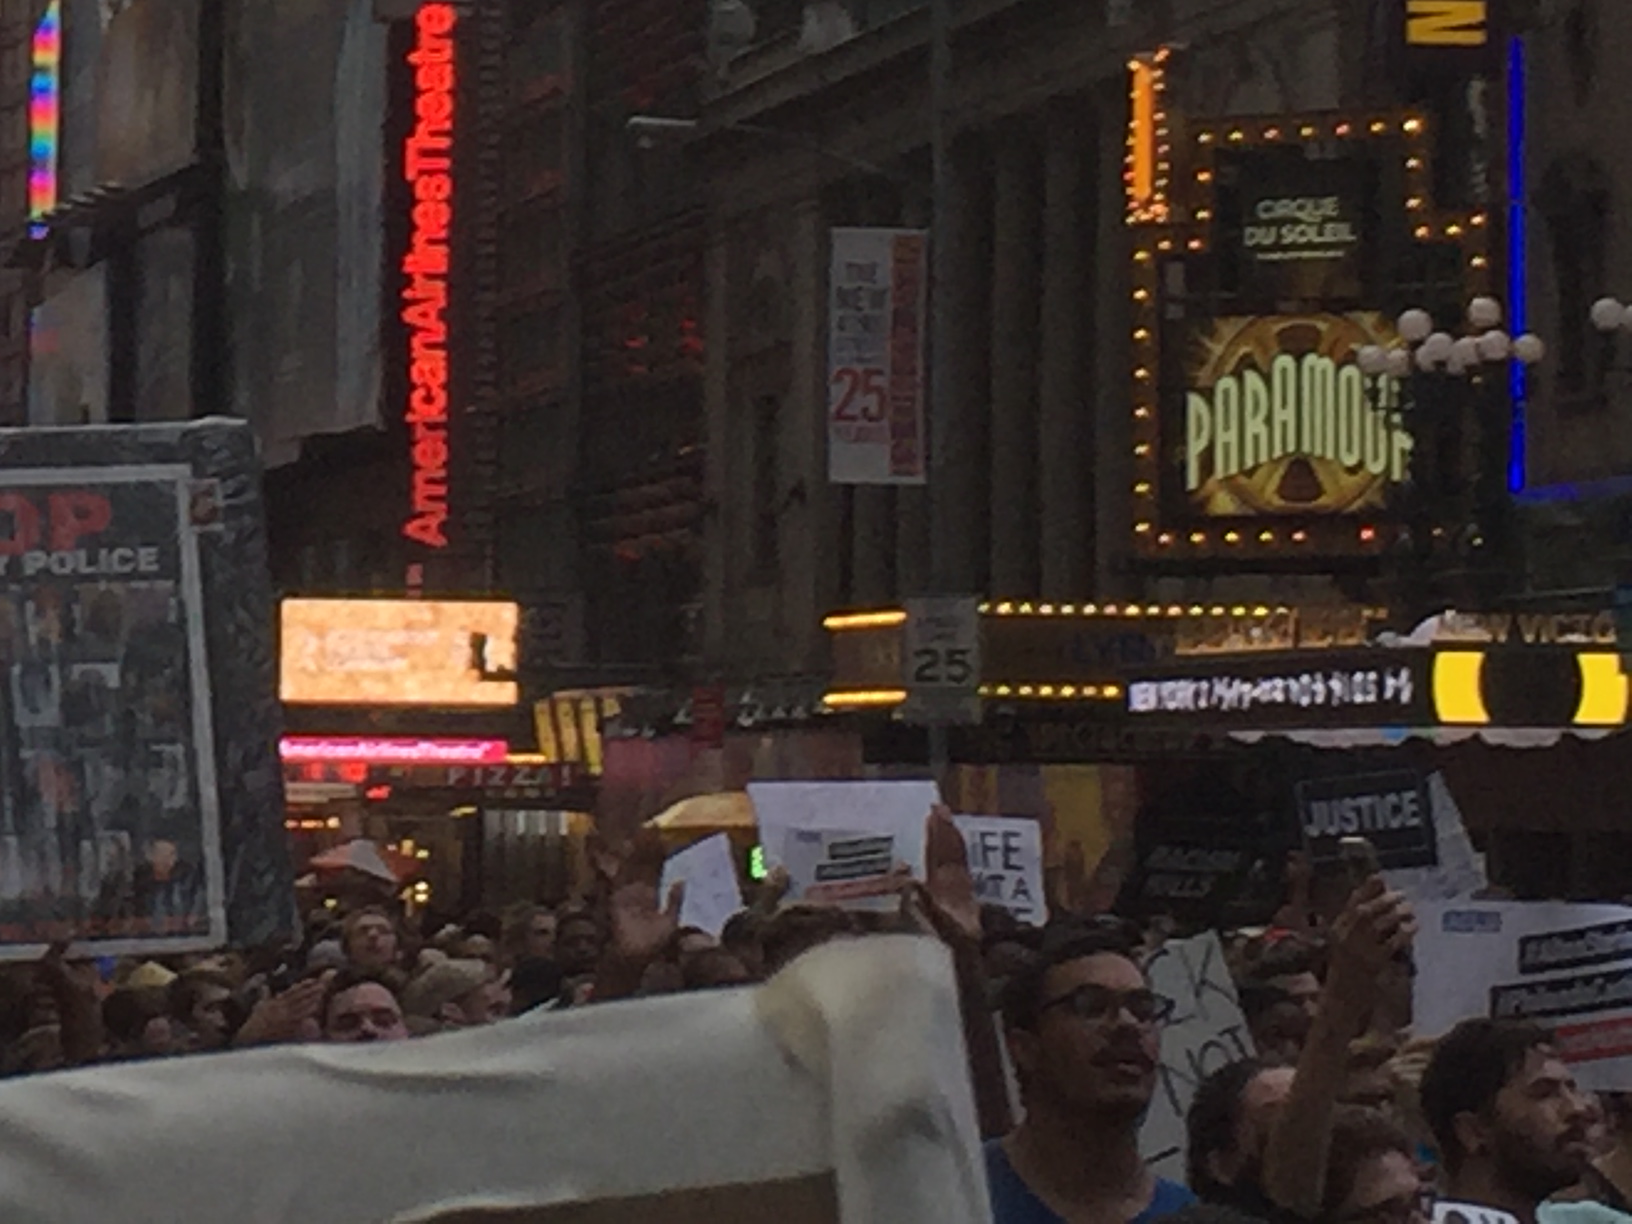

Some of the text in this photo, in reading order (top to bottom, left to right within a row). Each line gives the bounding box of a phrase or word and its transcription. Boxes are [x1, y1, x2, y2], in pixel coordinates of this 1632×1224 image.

[1256, 196, 1339, 222] CIRQUE
[1243, 222, 1357, 246] DU SOLEIL
[832, 367, 887, 423] 25
[21, 546, 160, 577] POLICE
[913, 648, 972, 684] 25
[1304, 788, 1422, 837] JUSTICE
